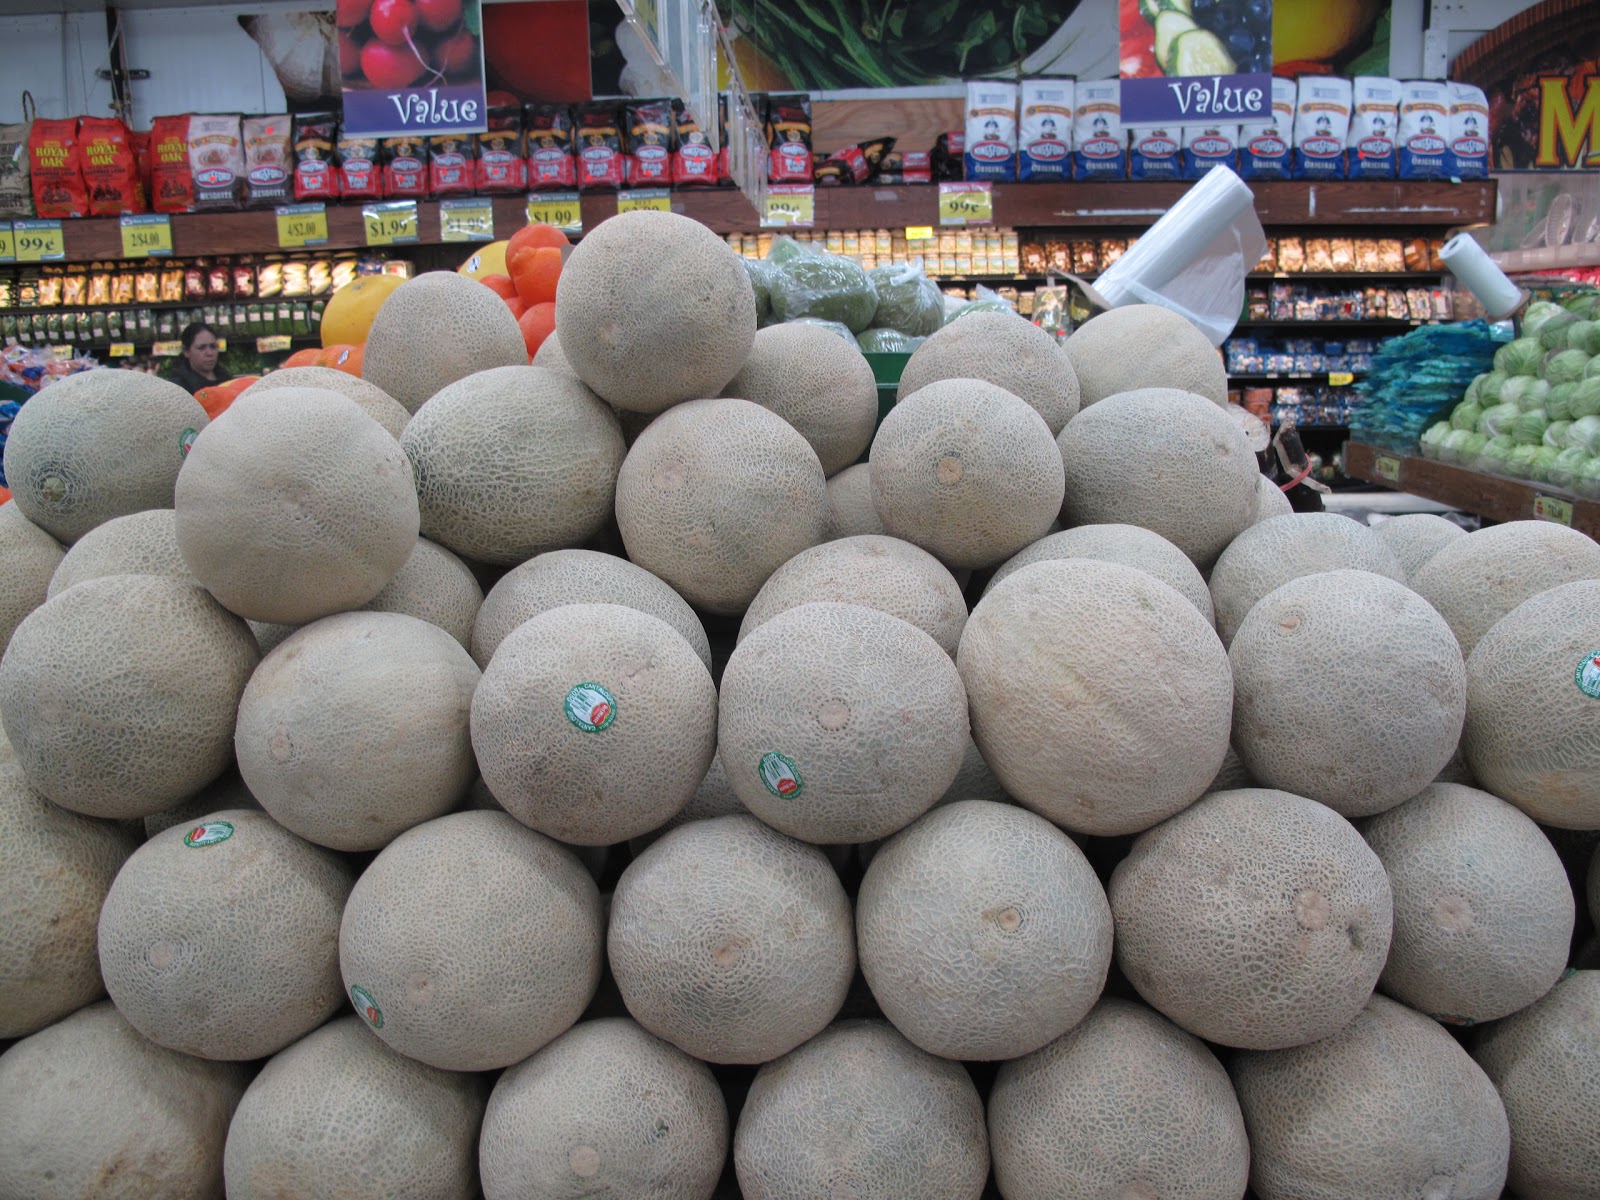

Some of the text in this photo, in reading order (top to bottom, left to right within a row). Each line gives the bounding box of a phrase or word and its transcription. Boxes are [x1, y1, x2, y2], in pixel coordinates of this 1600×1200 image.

[1168, 77, 1263, 114] Value
[388, 89, 478, 124] Value
[86, 144, 119, 156] ROYAL
[41, 158, 65, 168] OAK
[91, 155, 115, 166] OAK
[161, 153, 183, 163] OAK
[200, 191, 233, 201] MESQUITE
[252, 189, 286, 198] MESQUITE
[950, 201, 979, 213] 99¢
[534, 210, 572, 223] $199
[287, 222, 316, 237] 4/$2.00
[370, 219, 407, 238] $1.99
[20, 237, 55, 251] 99¢
[131, 230, 160, 248] 2/$4.00
